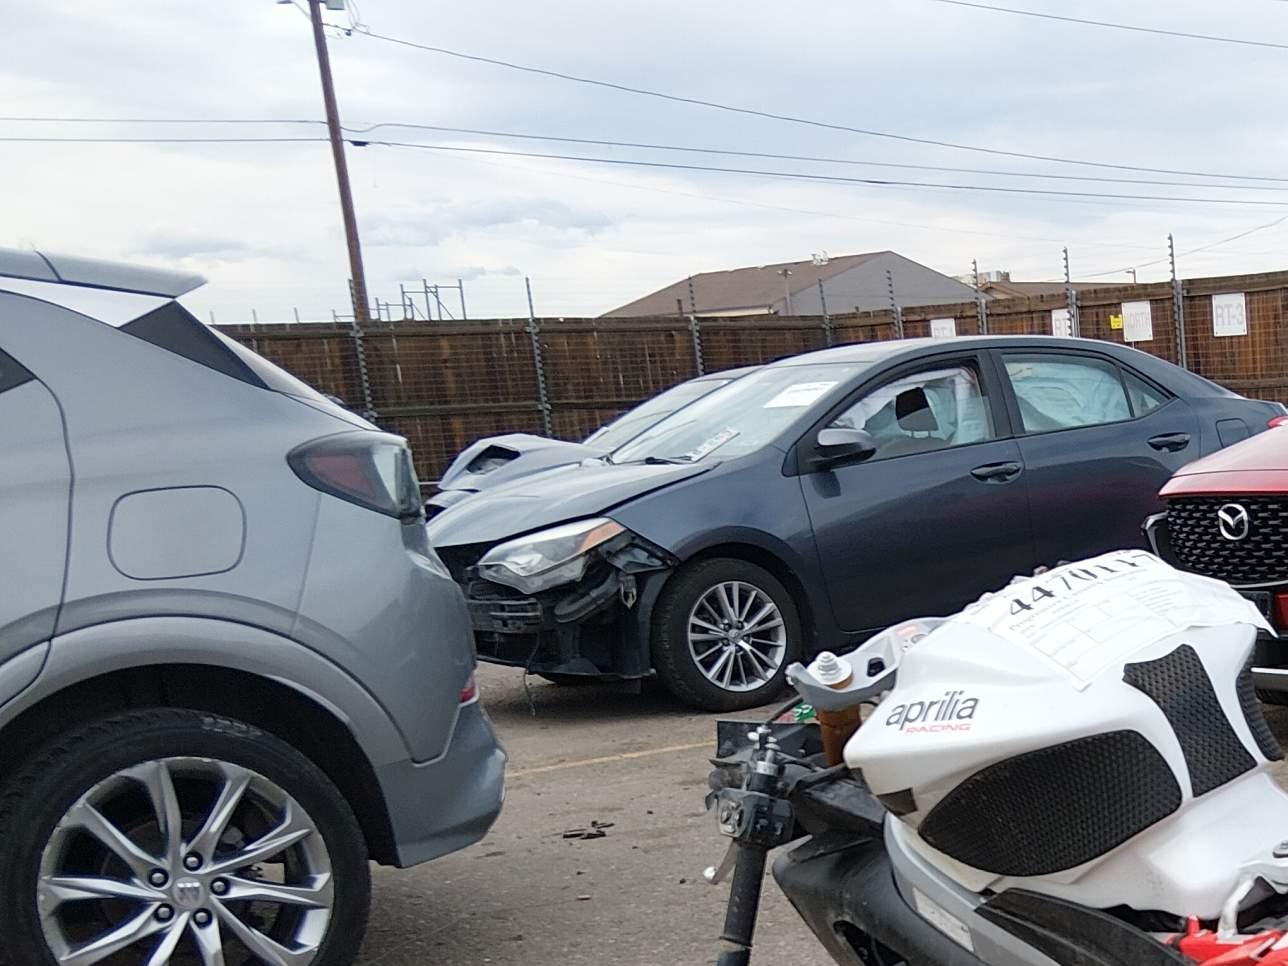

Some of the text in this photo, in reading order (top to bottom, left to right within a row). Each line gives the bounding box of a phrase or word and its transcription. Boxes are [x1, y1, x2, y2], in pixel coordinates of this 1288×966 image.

[1215, 303, 1244, 326] RT-3
[886, 690, 979, 731] aprilia
[905, 723, 971, 735] RACING
